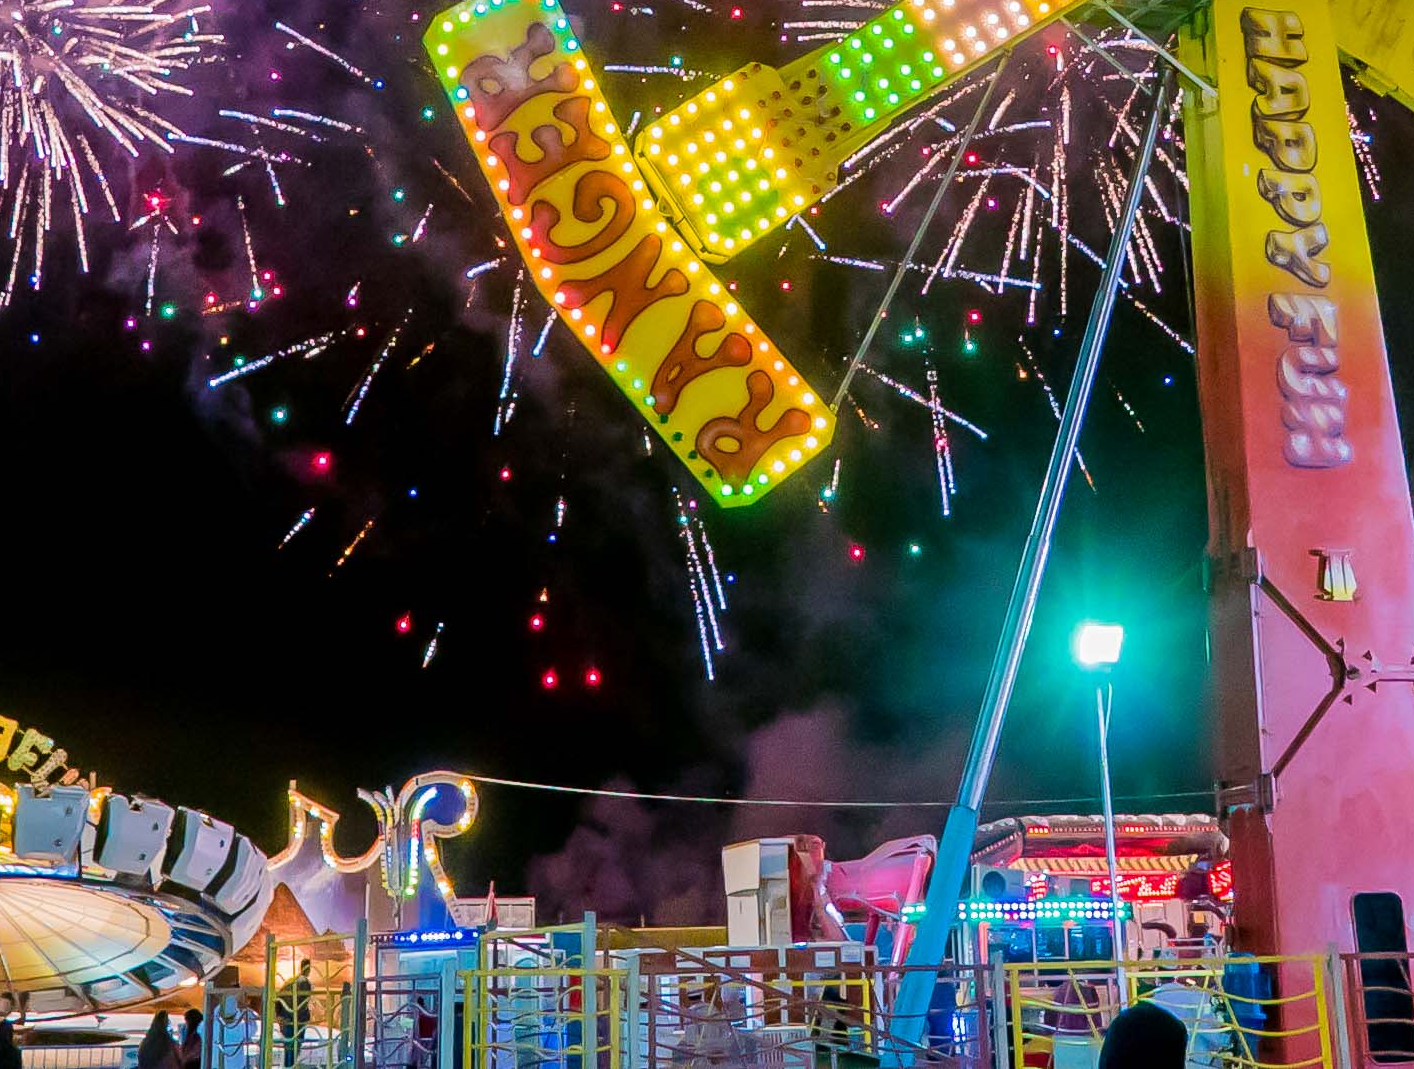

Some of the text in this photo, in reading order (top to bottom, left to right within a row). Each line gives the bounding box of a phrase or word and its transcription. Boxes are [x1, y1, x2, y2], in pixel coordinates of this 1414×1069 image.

[458, 21, 812, 496] RANGER
[1239, 6, 1353, 469] HAPPY FUN
